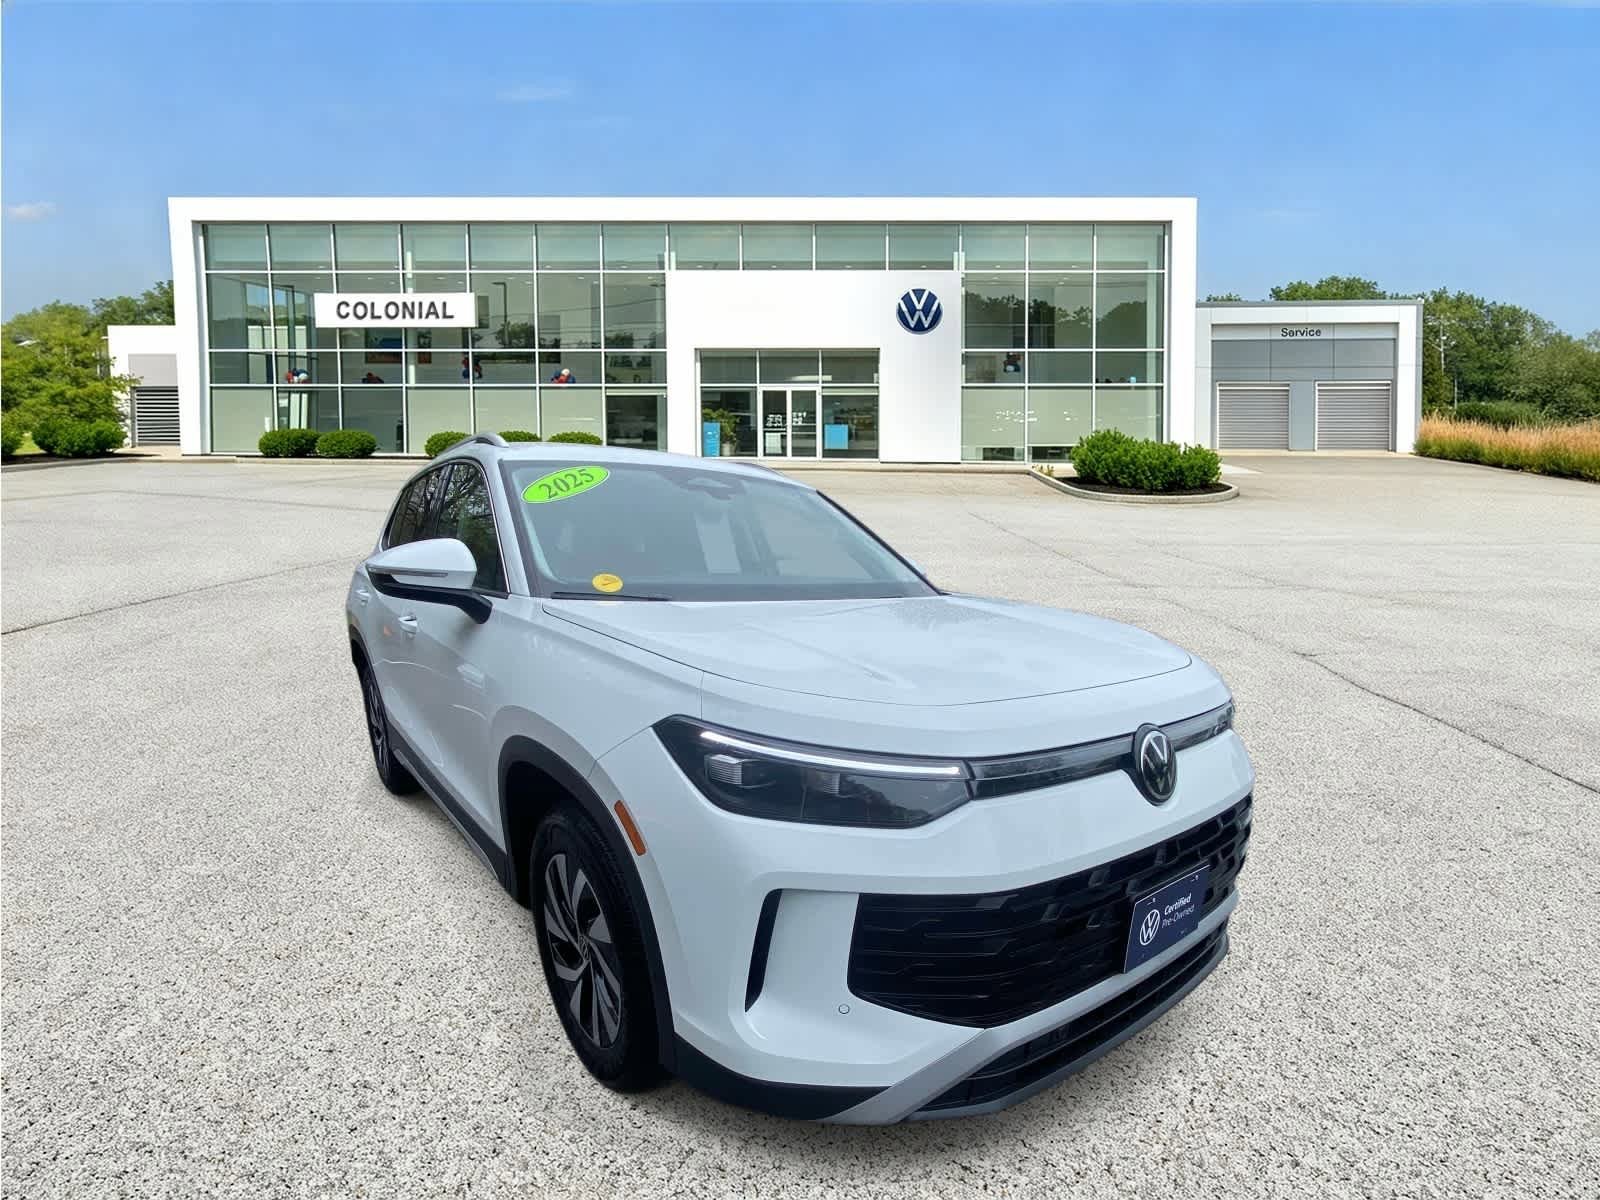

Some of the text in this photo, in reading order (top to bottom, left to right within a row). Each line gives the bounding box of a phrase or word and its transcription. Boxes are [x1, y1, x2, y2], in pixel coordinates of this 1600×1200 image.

[336, 301, 455, 320] COLONIAL
[898, 288, 941, 332] VW
[1281, 327, 1322, 337] Service
[538, 469, 594, 499] 2025
[1164, 892, 1192, 915] Certified
[1141, 909, 1159, 944] VW
[1162, 904, 1195, 928] Pre-Owned
